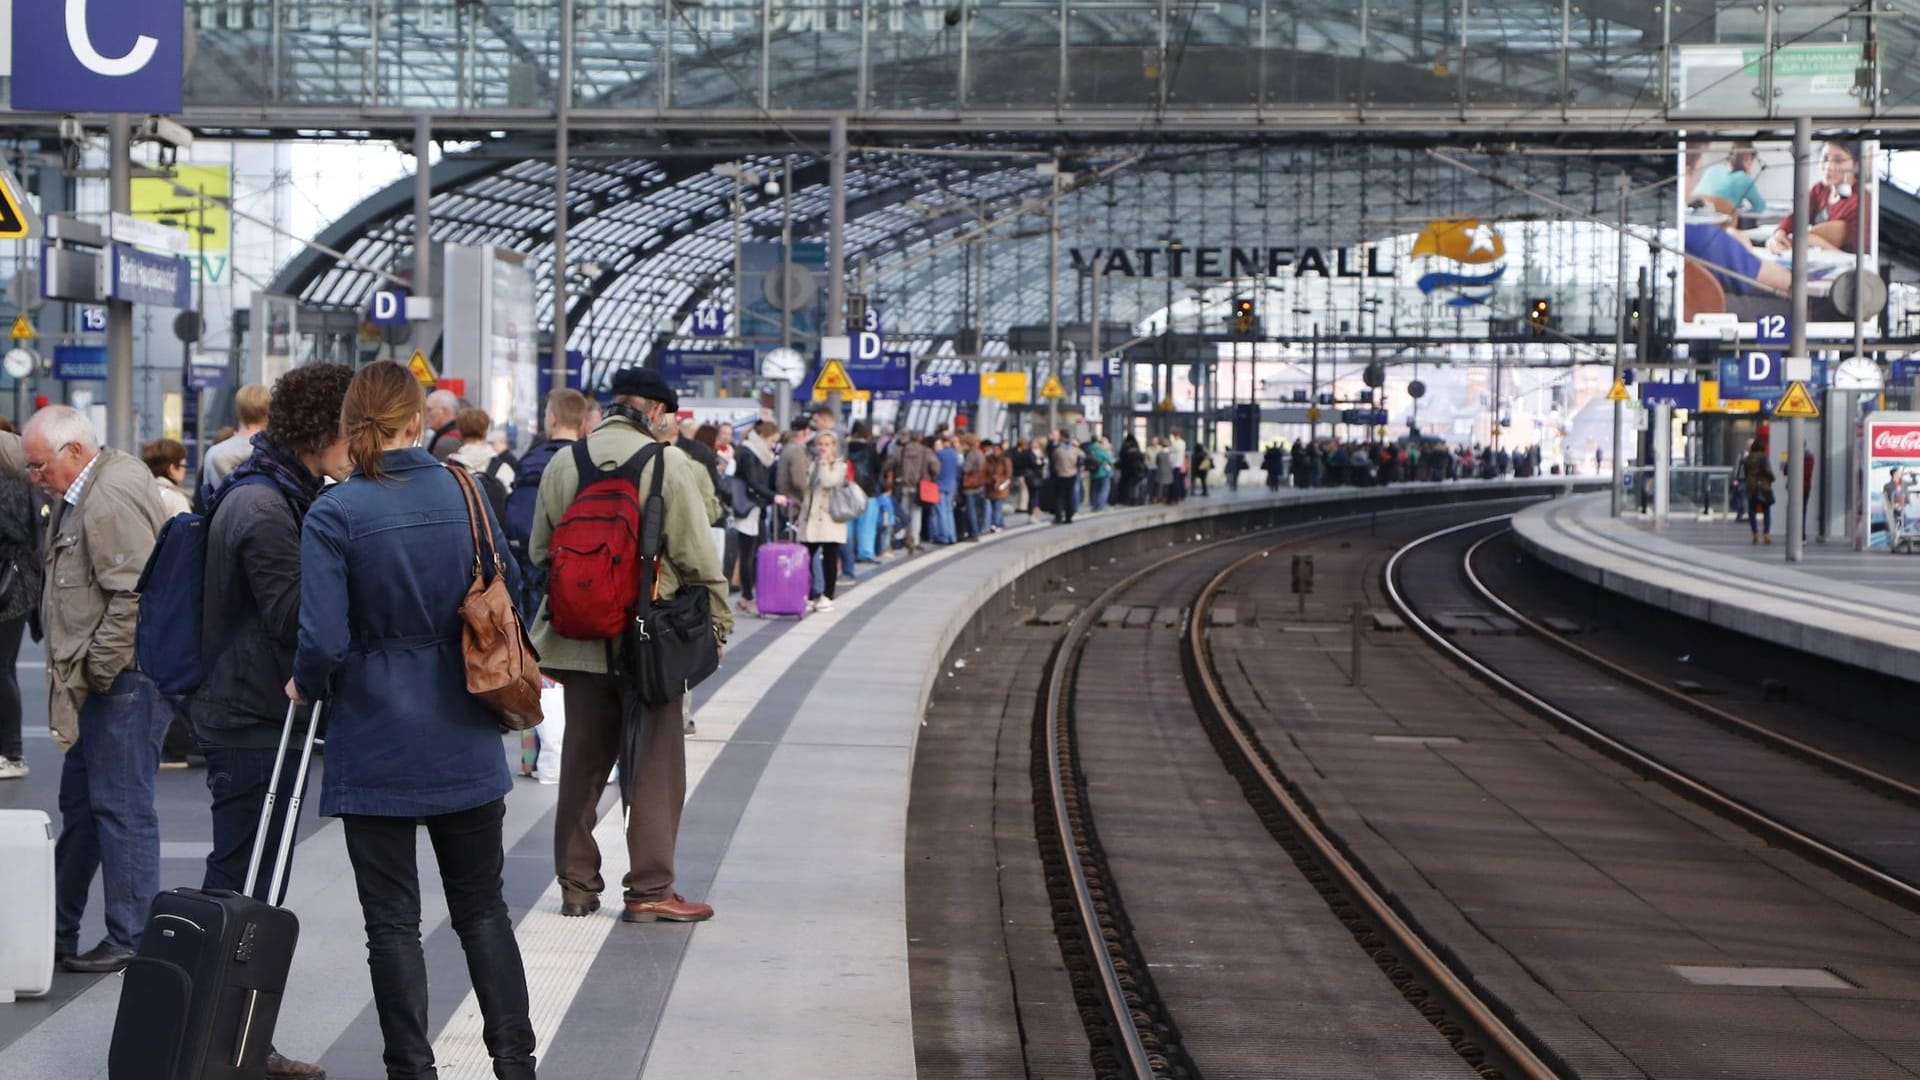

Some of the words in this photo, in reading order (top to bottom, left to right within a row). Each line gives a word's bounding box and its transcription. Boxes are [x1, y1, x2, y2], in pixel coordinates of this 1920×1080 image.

[65, 0, 160, 77] C
[1071, 246, 1394, 278] VATTENFALL
[84, 309, 106, 329] 15
[376, 291, 397, 319] D
[694, 308, 718, 330] 14
[1759, 315, 1785, 338] 12
[859, 332, 881, 360] D
[1108, 357, 1121, 375] E
[1748, 352, 1771, 381] D
